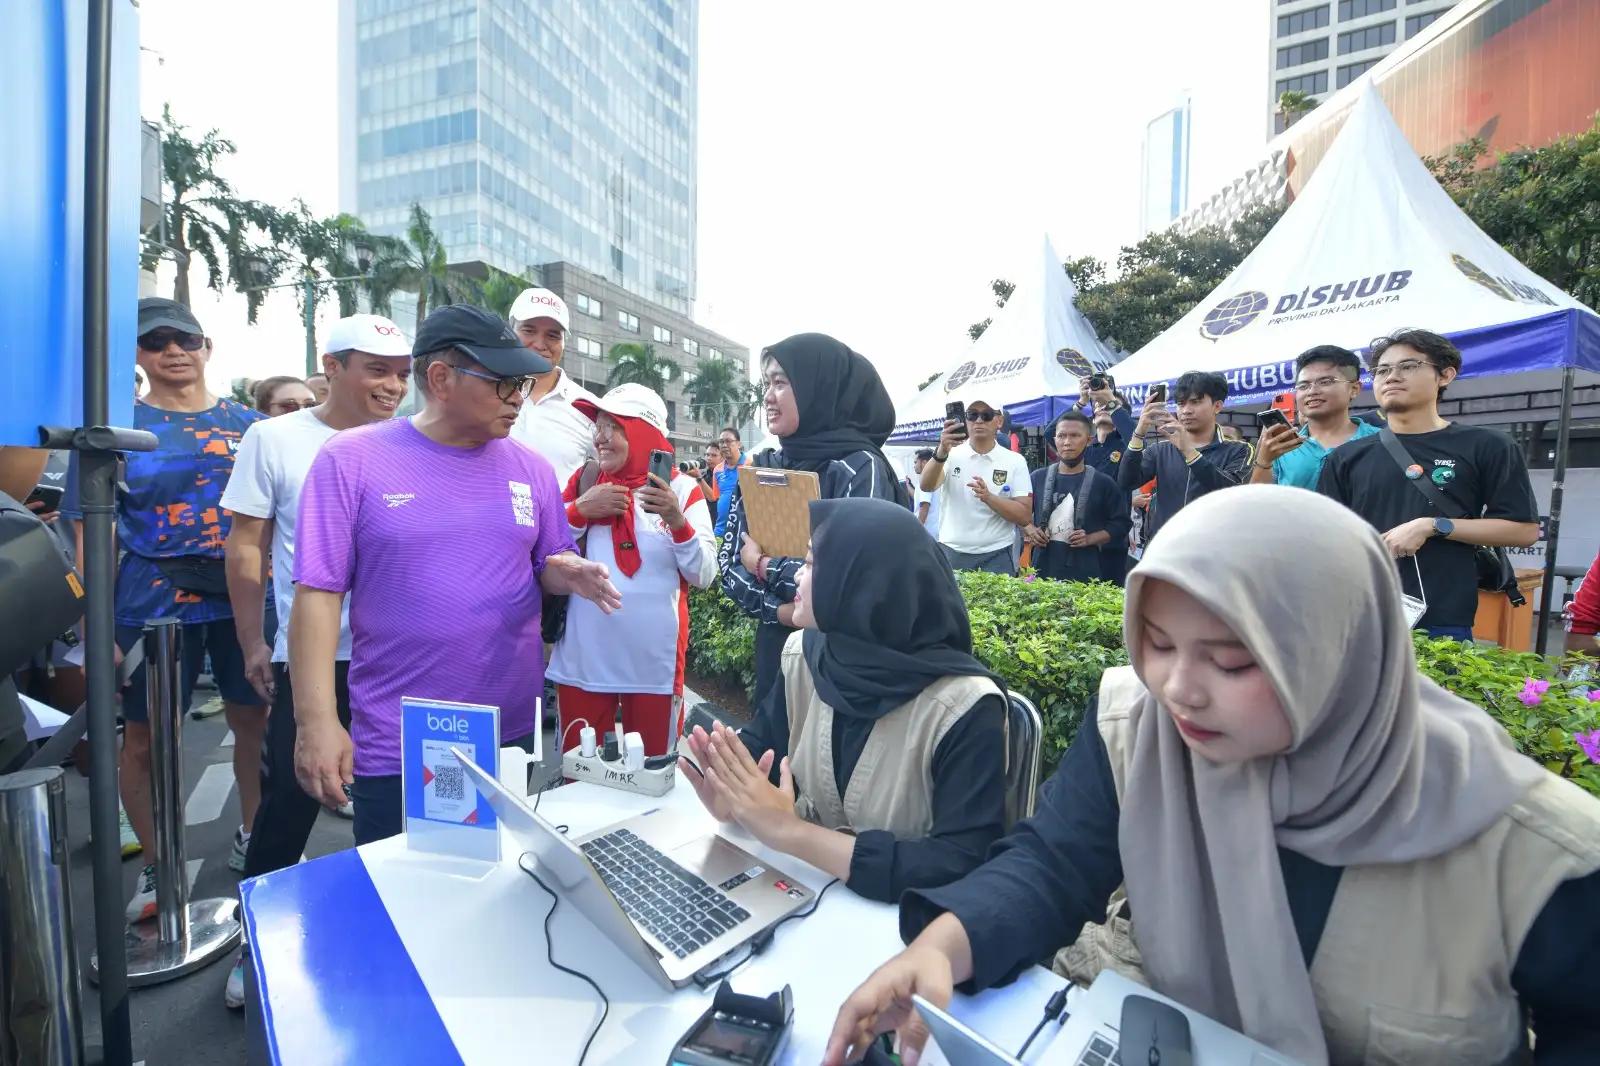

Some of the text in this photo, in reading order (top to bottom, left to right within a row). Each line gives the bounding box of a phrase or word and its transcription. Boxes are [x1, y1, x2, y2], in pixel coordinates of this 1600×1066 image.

[530, 295, 560, 310] bale
[1272, 269, 1413, 315] DISHUB
[1267, 294, 1400, 326] PROVINSI DKI JAKARTA
[975, 356, 1032, 378] DISHUB
[718, 531, 736, 591] ORGANR
[1503, 546, 1547, 556] KART
[427, 712, 469, 733] bale
